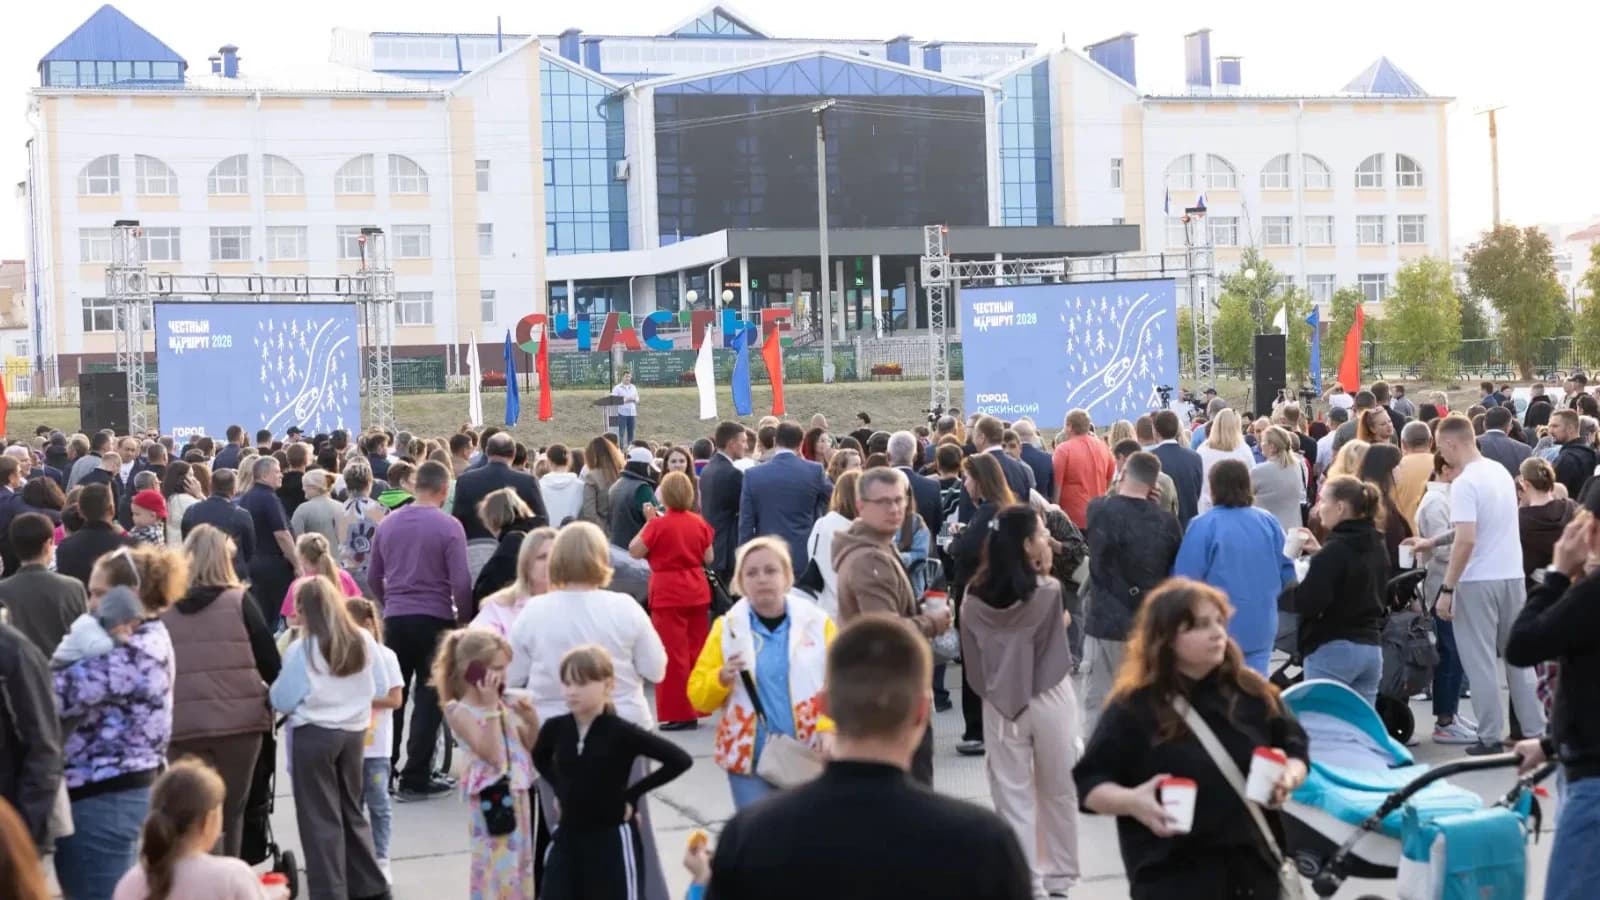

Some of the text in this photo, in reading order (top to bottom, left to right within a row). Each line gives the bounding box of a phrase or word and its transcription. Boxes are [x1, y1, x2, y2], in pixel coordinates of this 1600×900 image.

[973, 300, 1014, 315] ЧЕСТНЫЙ
[168, 320, 209, 334] ЧЕСТНЫЙ
[973, 314, 1014, 332] МАРШРУТ
[515, 308, 794, 353] СЧАСТЬЕ
[976, 393, 1009, 404] ГОРОД
[977, 402, 1039, 415] ГУБКИНСКИЙ
[173, 426, 205, 437] ГОРОД
